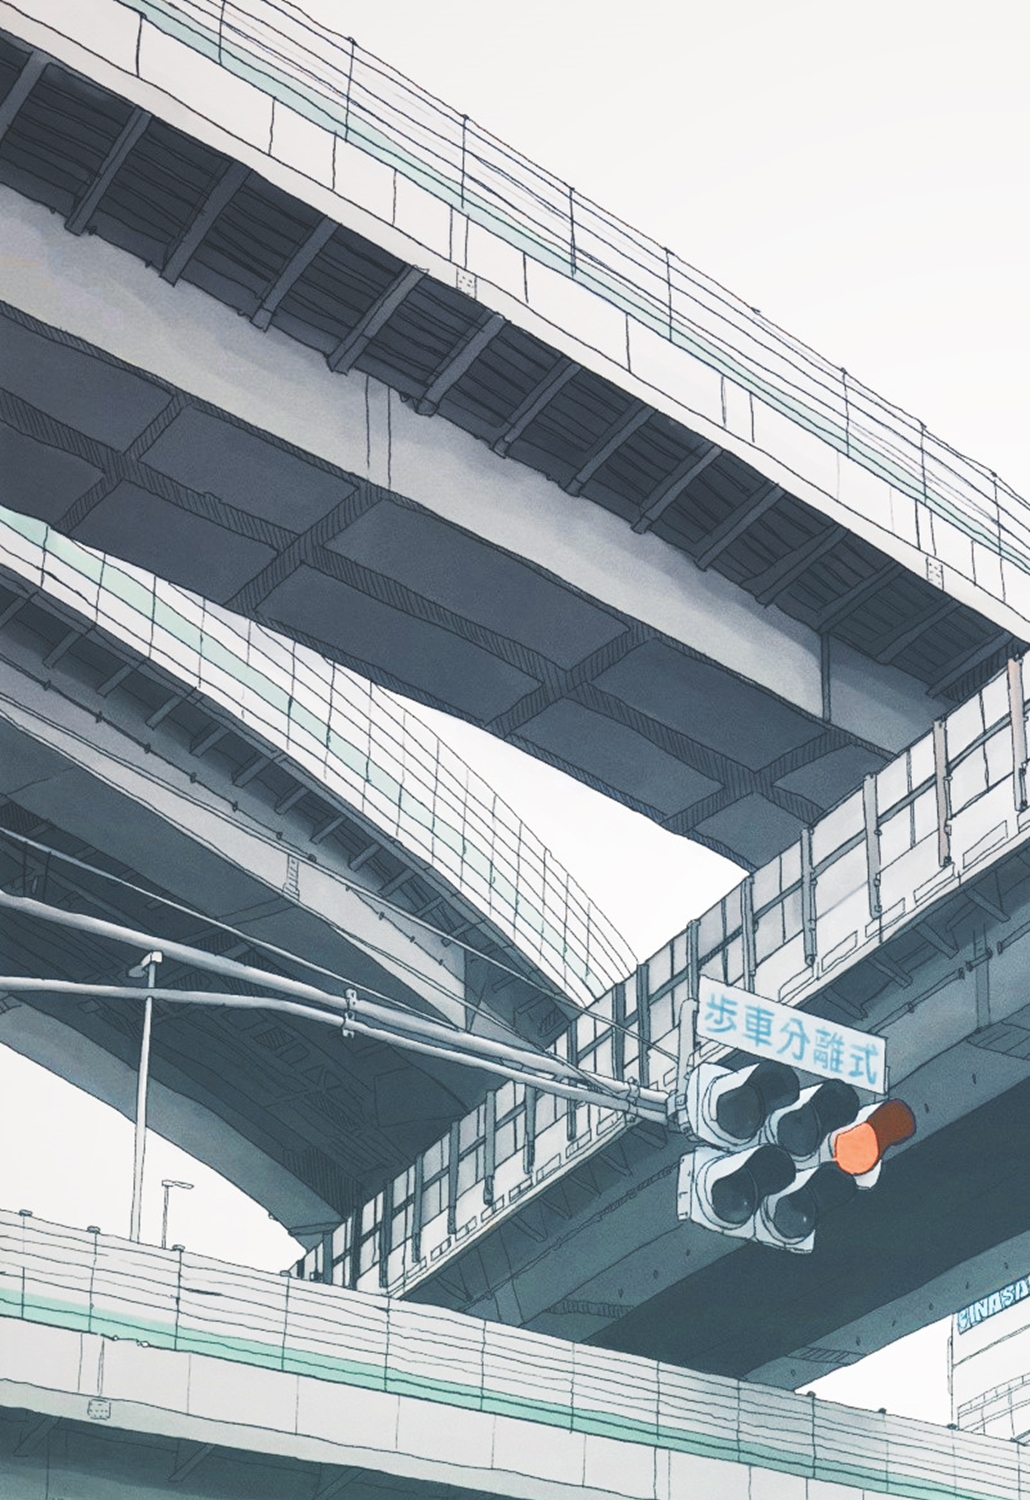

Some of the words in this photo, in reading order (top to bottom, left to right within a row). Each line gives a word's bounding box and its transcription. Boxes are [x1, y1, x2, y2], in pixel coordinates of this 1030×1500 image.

[705, 992, 878, 1086] 歩車分離式
